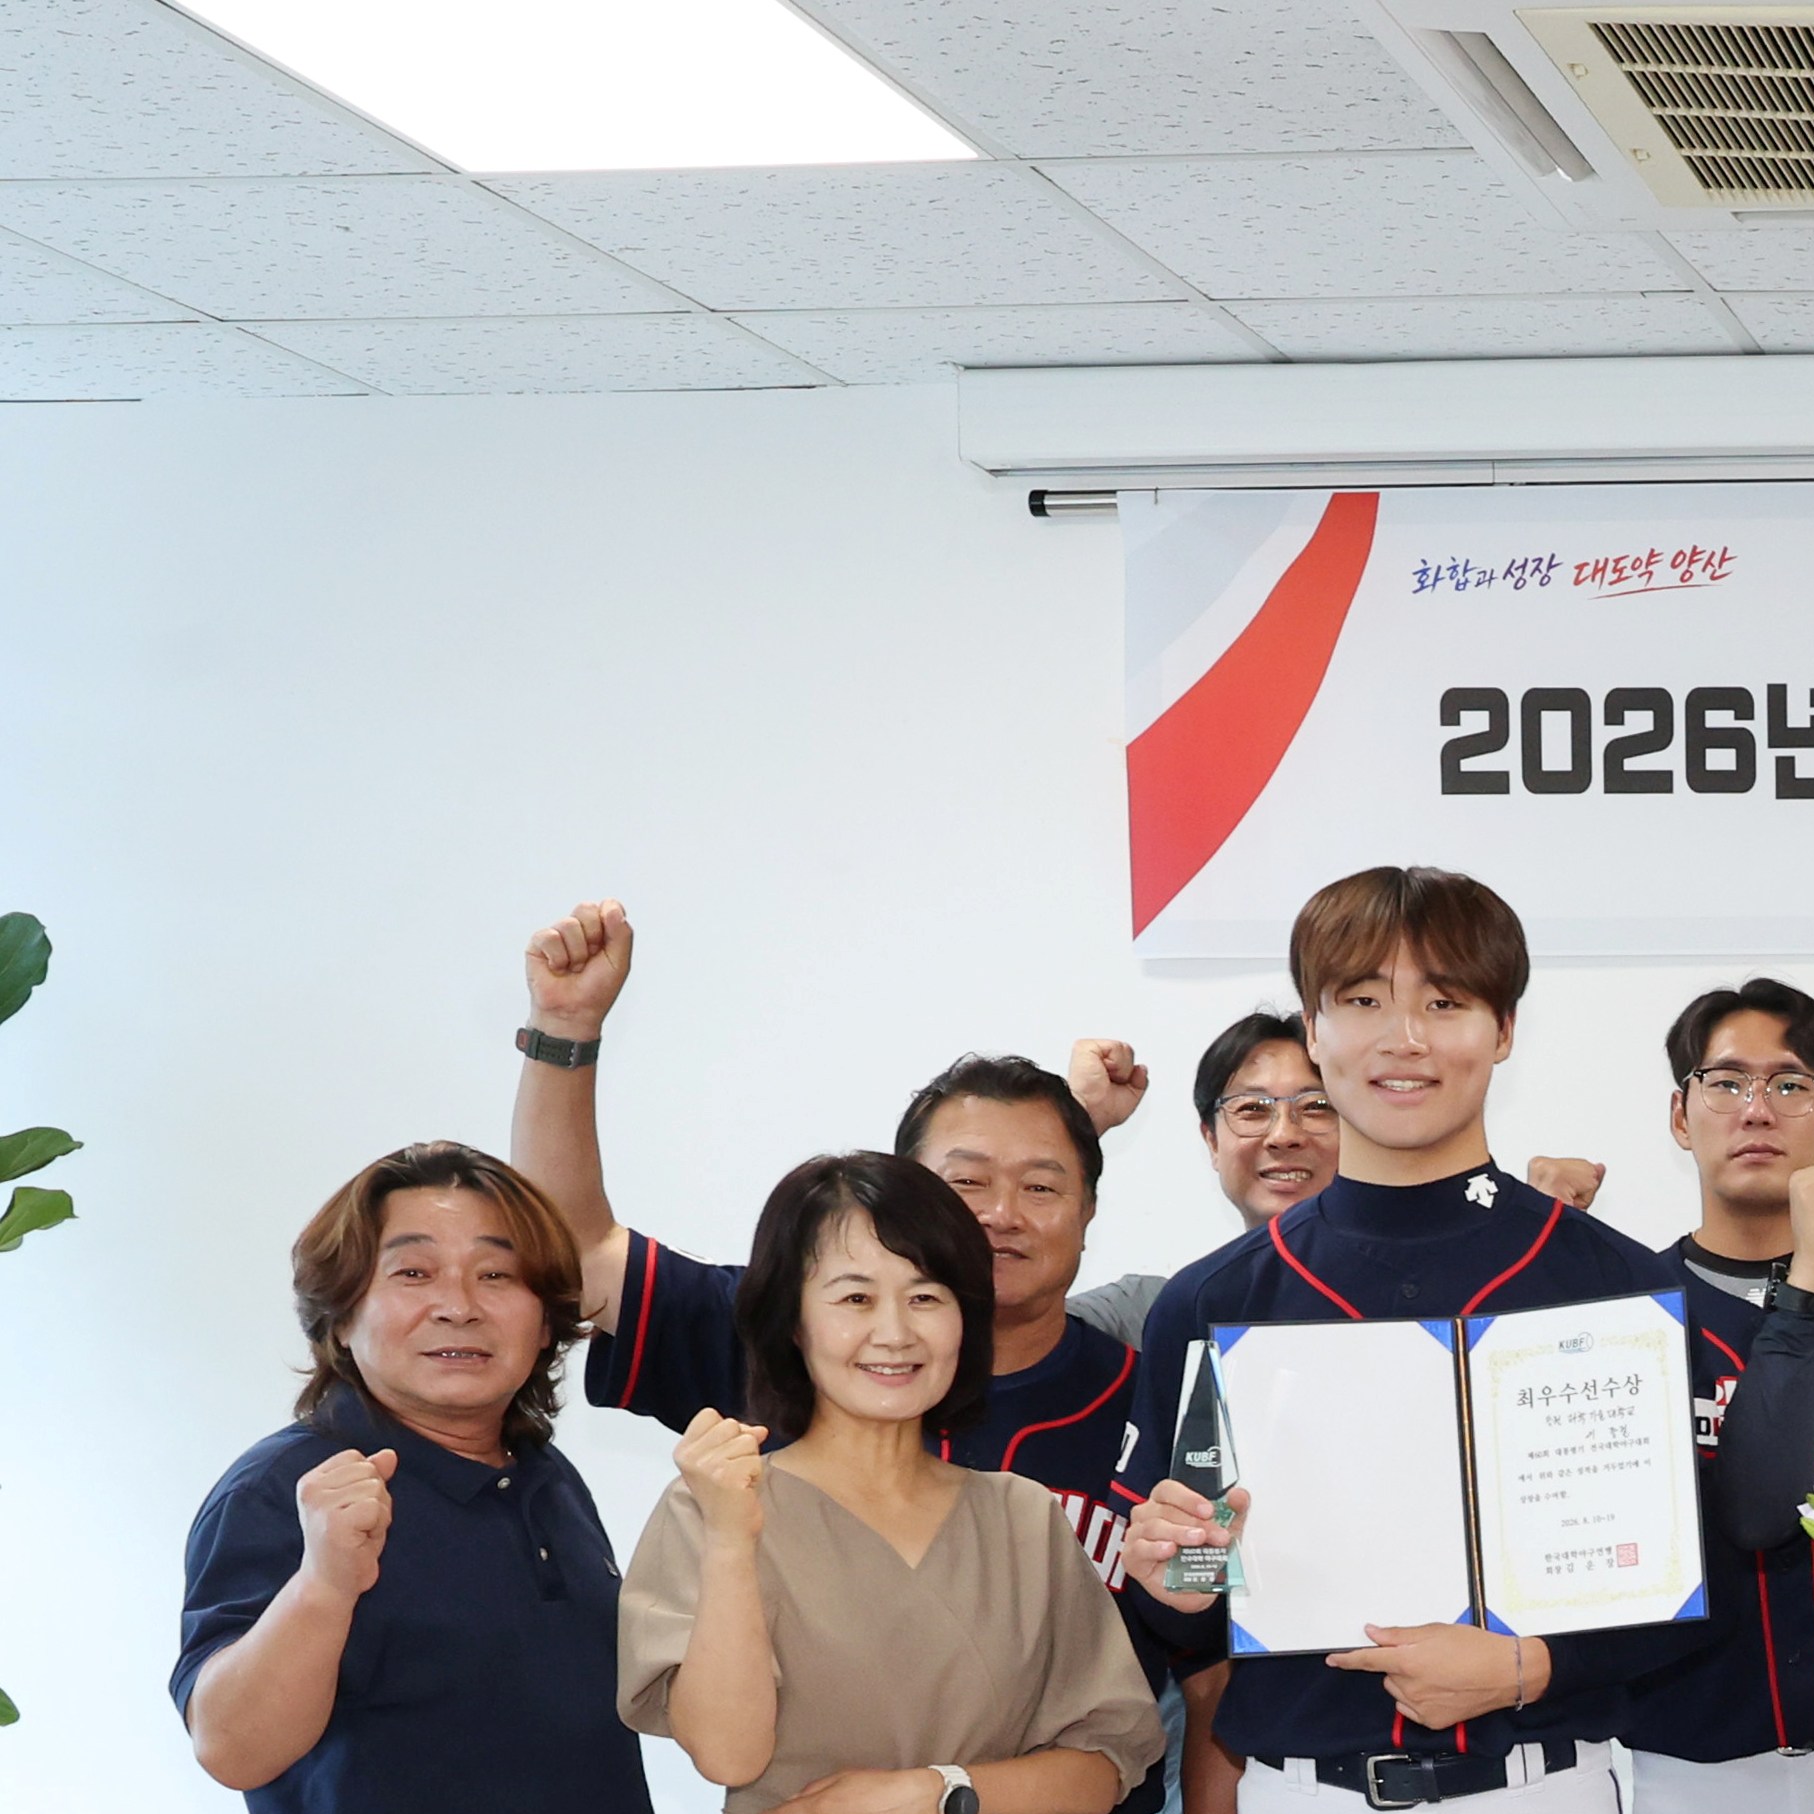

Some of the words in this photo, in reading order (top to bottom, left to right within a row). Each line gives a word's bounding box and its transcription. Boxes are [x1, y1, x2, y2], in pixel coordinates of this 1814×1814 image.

[1412, 556, 1498, 594] 화합과
[1502, 553, 1564, 590] 성장
[1572, 547, 1664, 591] 대도약
[1670, 545, 1738, 583] 양산
[1516, 1373, 1643, 1409] 최우수선수상
[1185, 1452, 1217, 1463] KUBF
